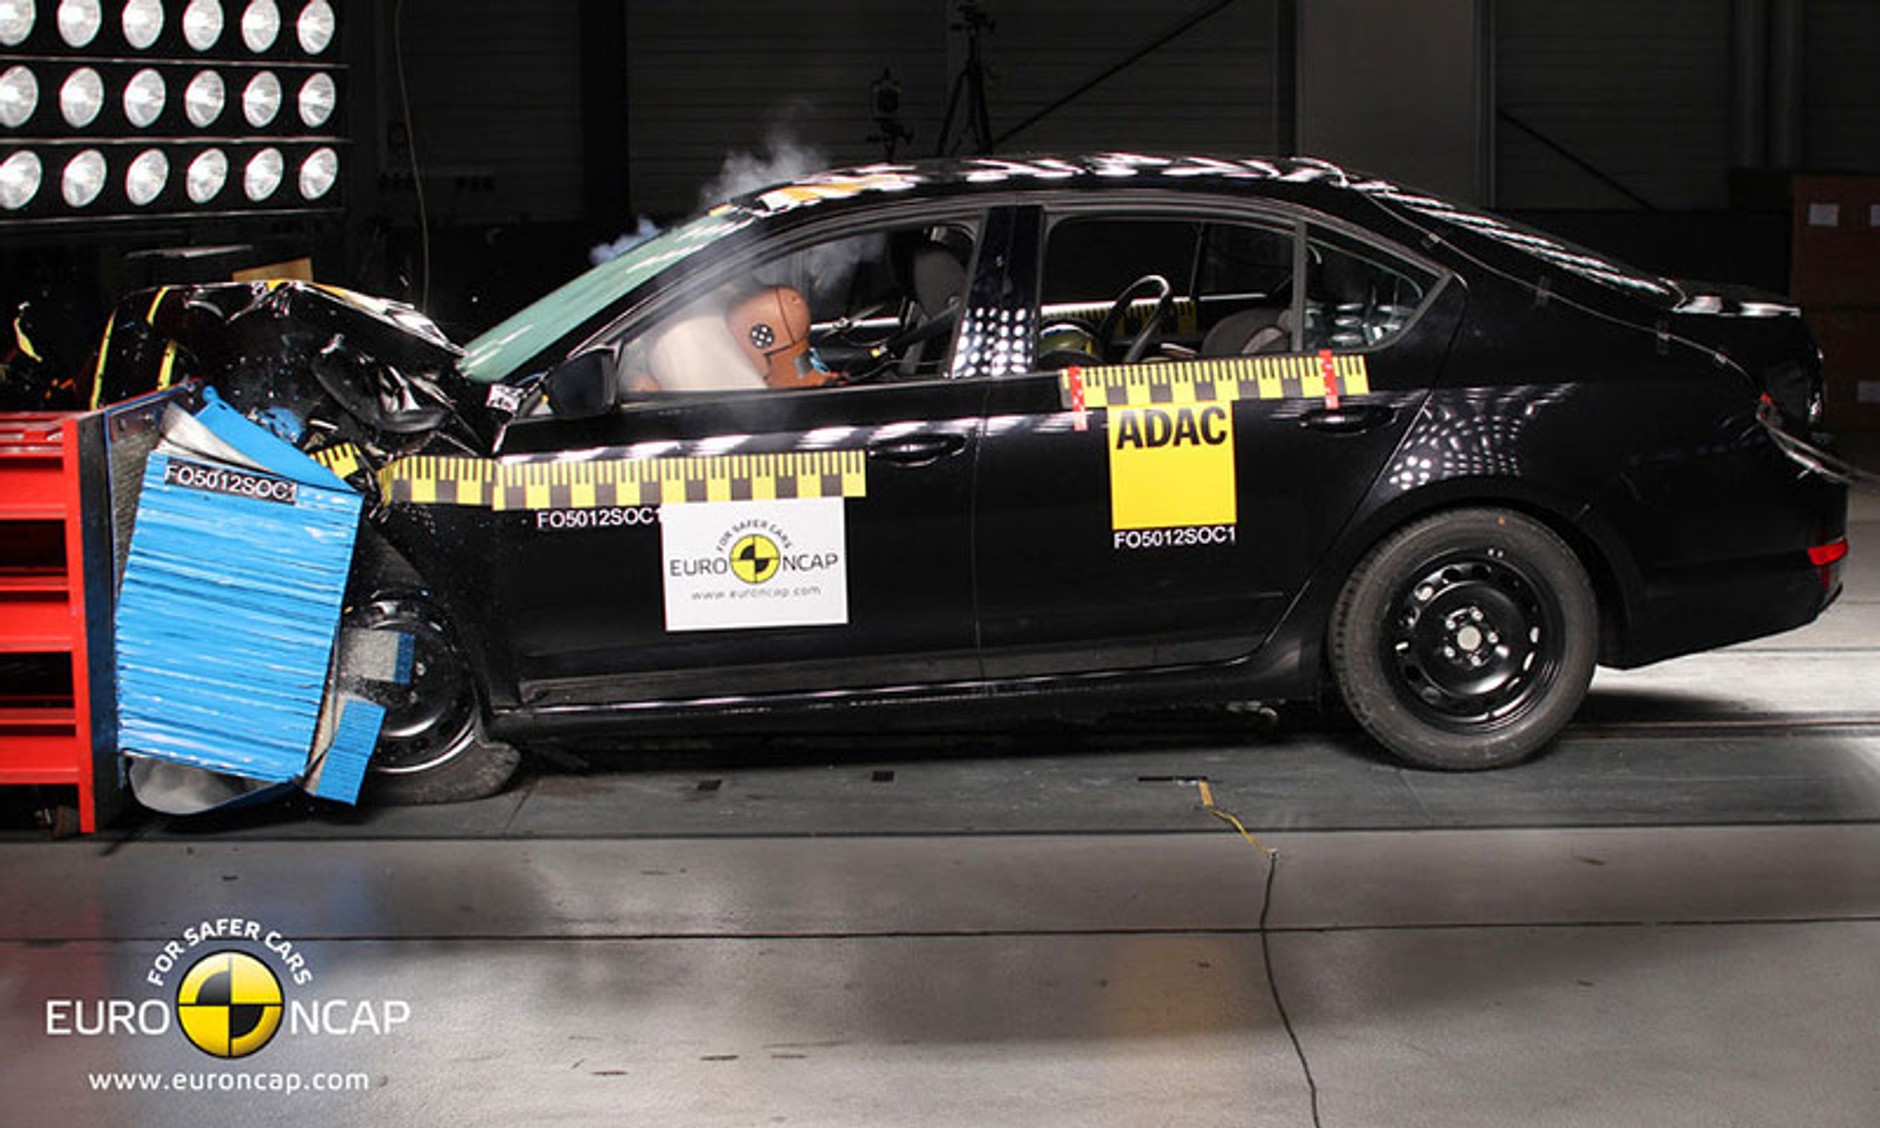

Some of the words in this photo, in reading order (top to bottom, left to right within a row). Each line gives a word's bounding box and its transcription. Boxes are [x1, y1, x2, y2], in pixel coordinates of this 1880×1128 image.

[1116, 406, 1228, 450] ADAC
[715, 530, 733, 553] FOR
[732, 519, 768, 534] SAFER
[768, 523, 794, 550] CARS
[1113, 526, 1236, 550] FO5012SOC1
[669, 557, 728, 577] EURO
[783, 553, 839, 573] NCAP
